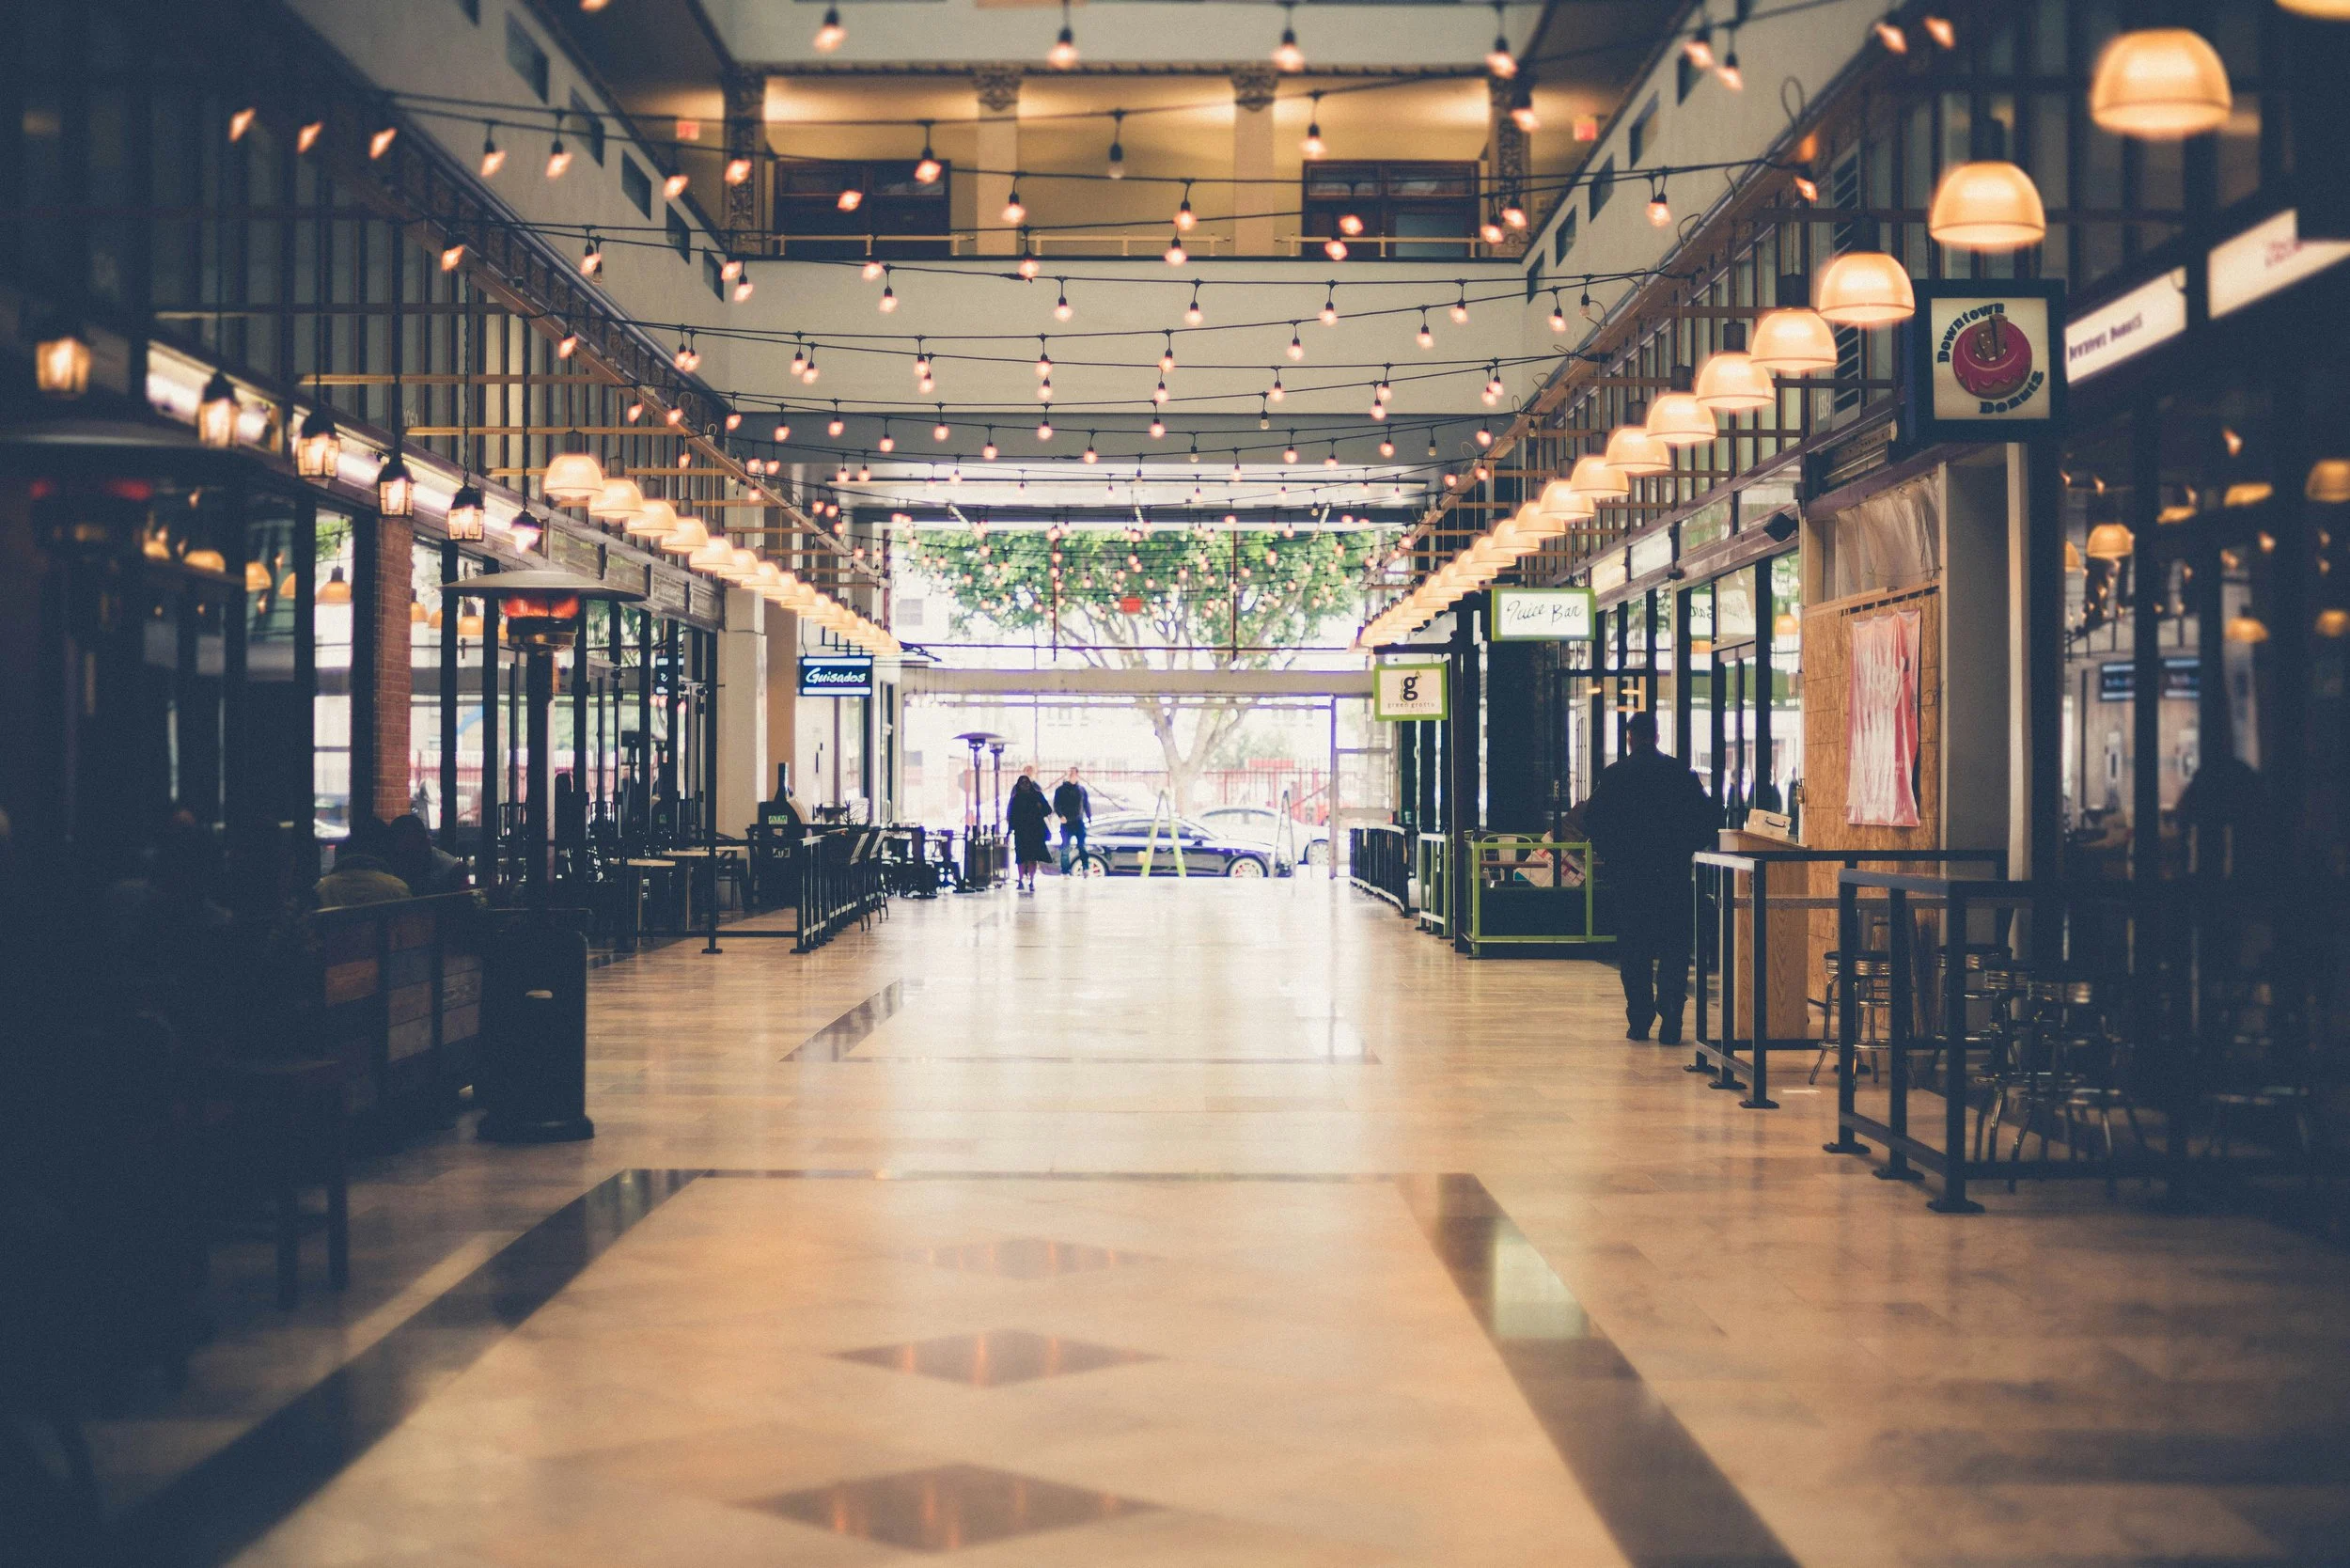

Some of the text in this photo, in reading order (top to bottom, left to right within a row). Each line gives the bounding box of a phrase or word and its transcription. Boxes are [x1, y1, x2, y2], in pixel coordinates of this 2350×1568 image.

[1506, 600, 1583, 626] Juice Bar
[806, 666, 867, 684] Guisados
